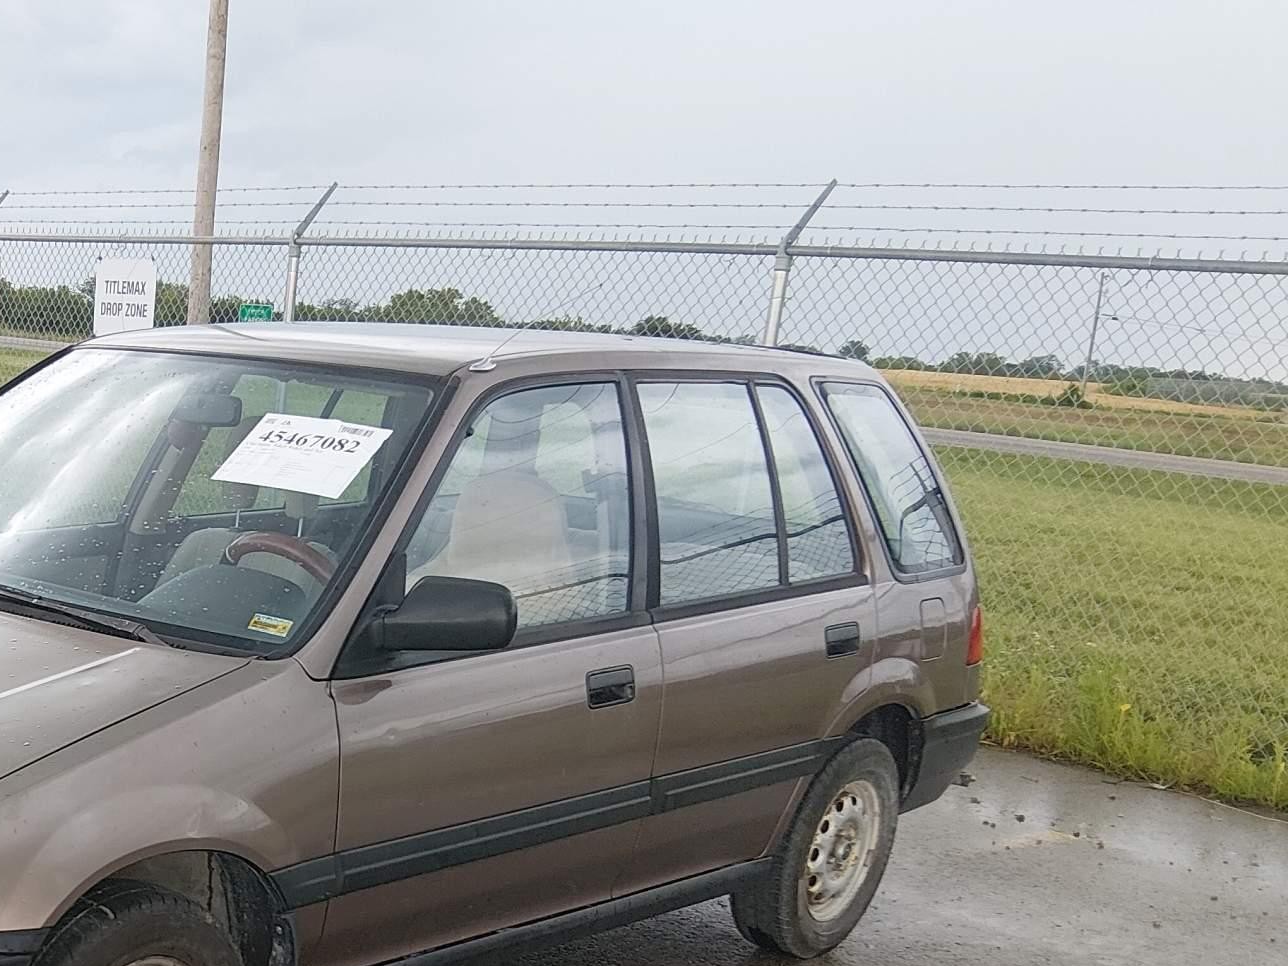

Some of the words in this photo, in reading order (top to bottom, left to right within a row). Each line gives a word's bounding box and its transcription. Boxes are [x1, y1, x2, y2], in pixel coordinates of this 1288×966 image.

[104, 280, 147, 295] TITLEMAX
[100, 302, 123, 316] DROP
[125, 303, 148, 318] ZONE
[258, 429, 361, 453] 45467082
